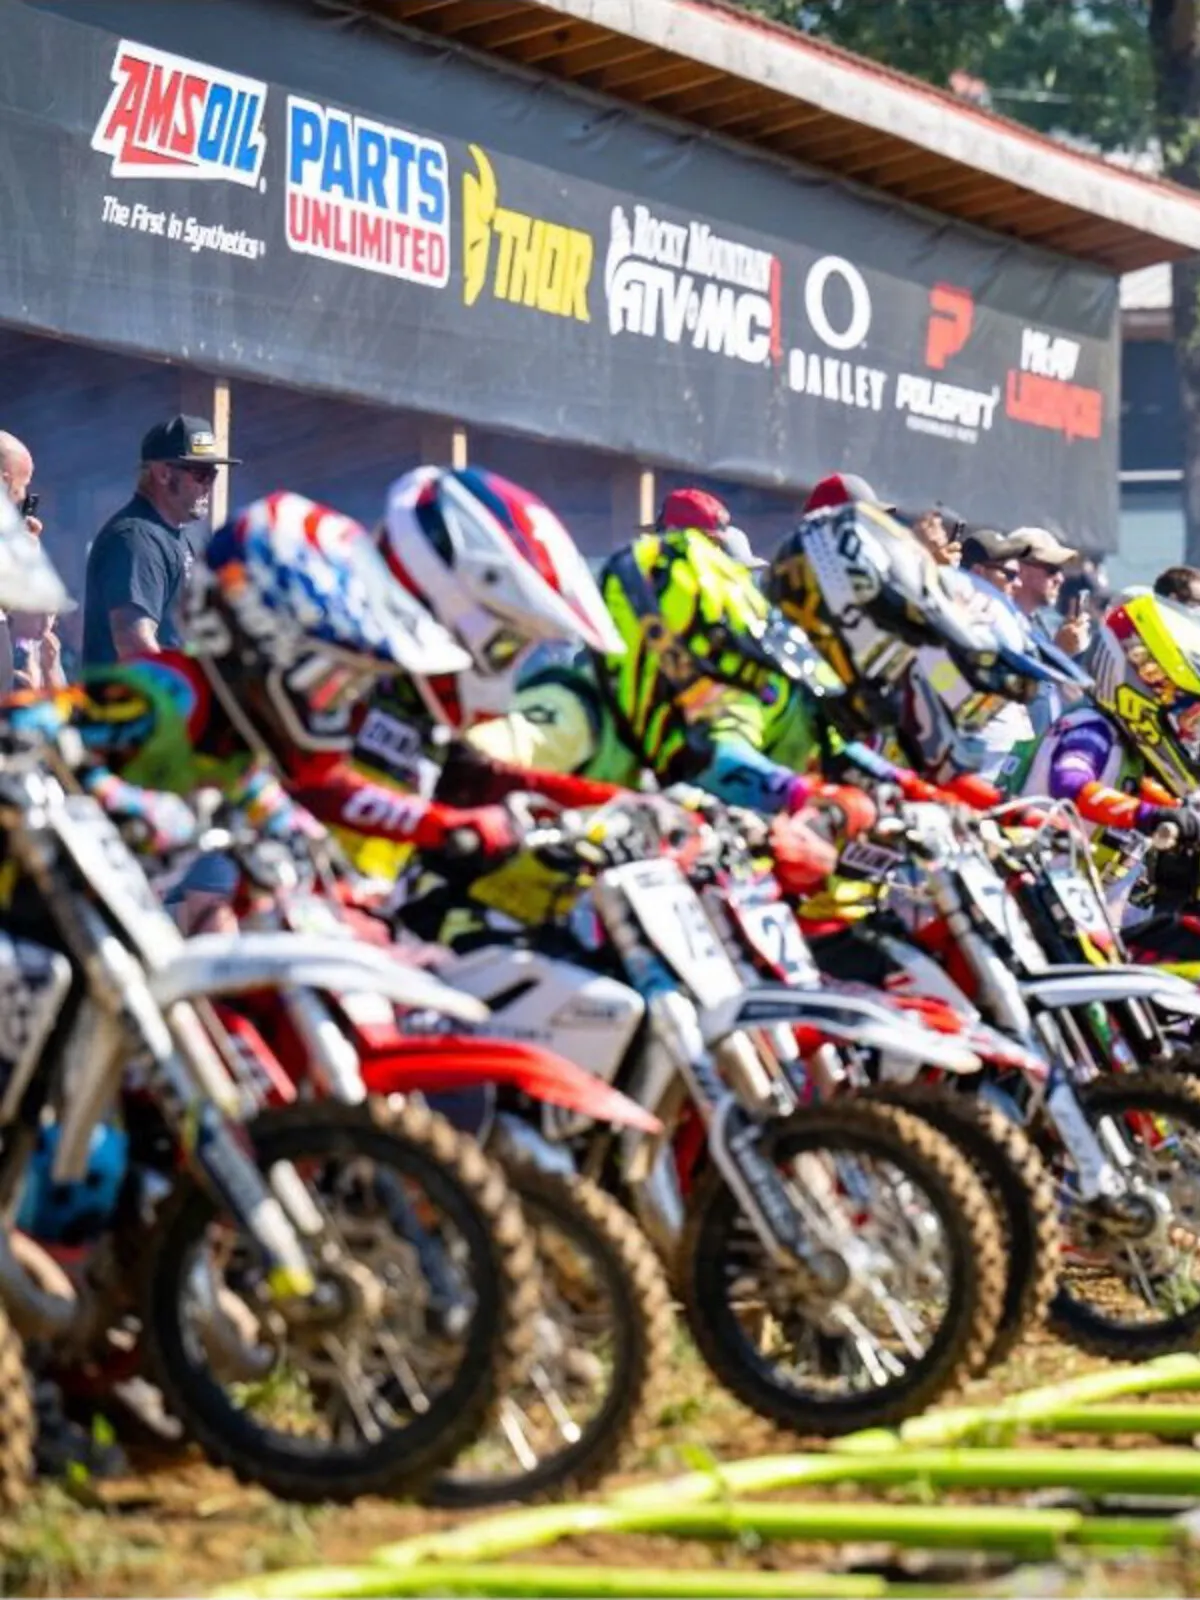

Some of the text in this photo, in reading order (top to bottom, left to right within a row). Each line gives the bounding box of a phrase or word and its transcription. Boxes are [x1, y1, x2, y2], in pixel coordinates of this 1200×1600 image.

[103, 54, 264, 172] AMSOIL
[289, 104, 446, 225] PARTS
[102, 195, 130, 227] The
[131, 203, 166, 236] First
[184, 217, 260, 260] Synthetics
[288, 192, 446, 280] UNLIMITED
[492, 206, 594, 323] THOR
[789, 348, 887, 412] OAKLEY
